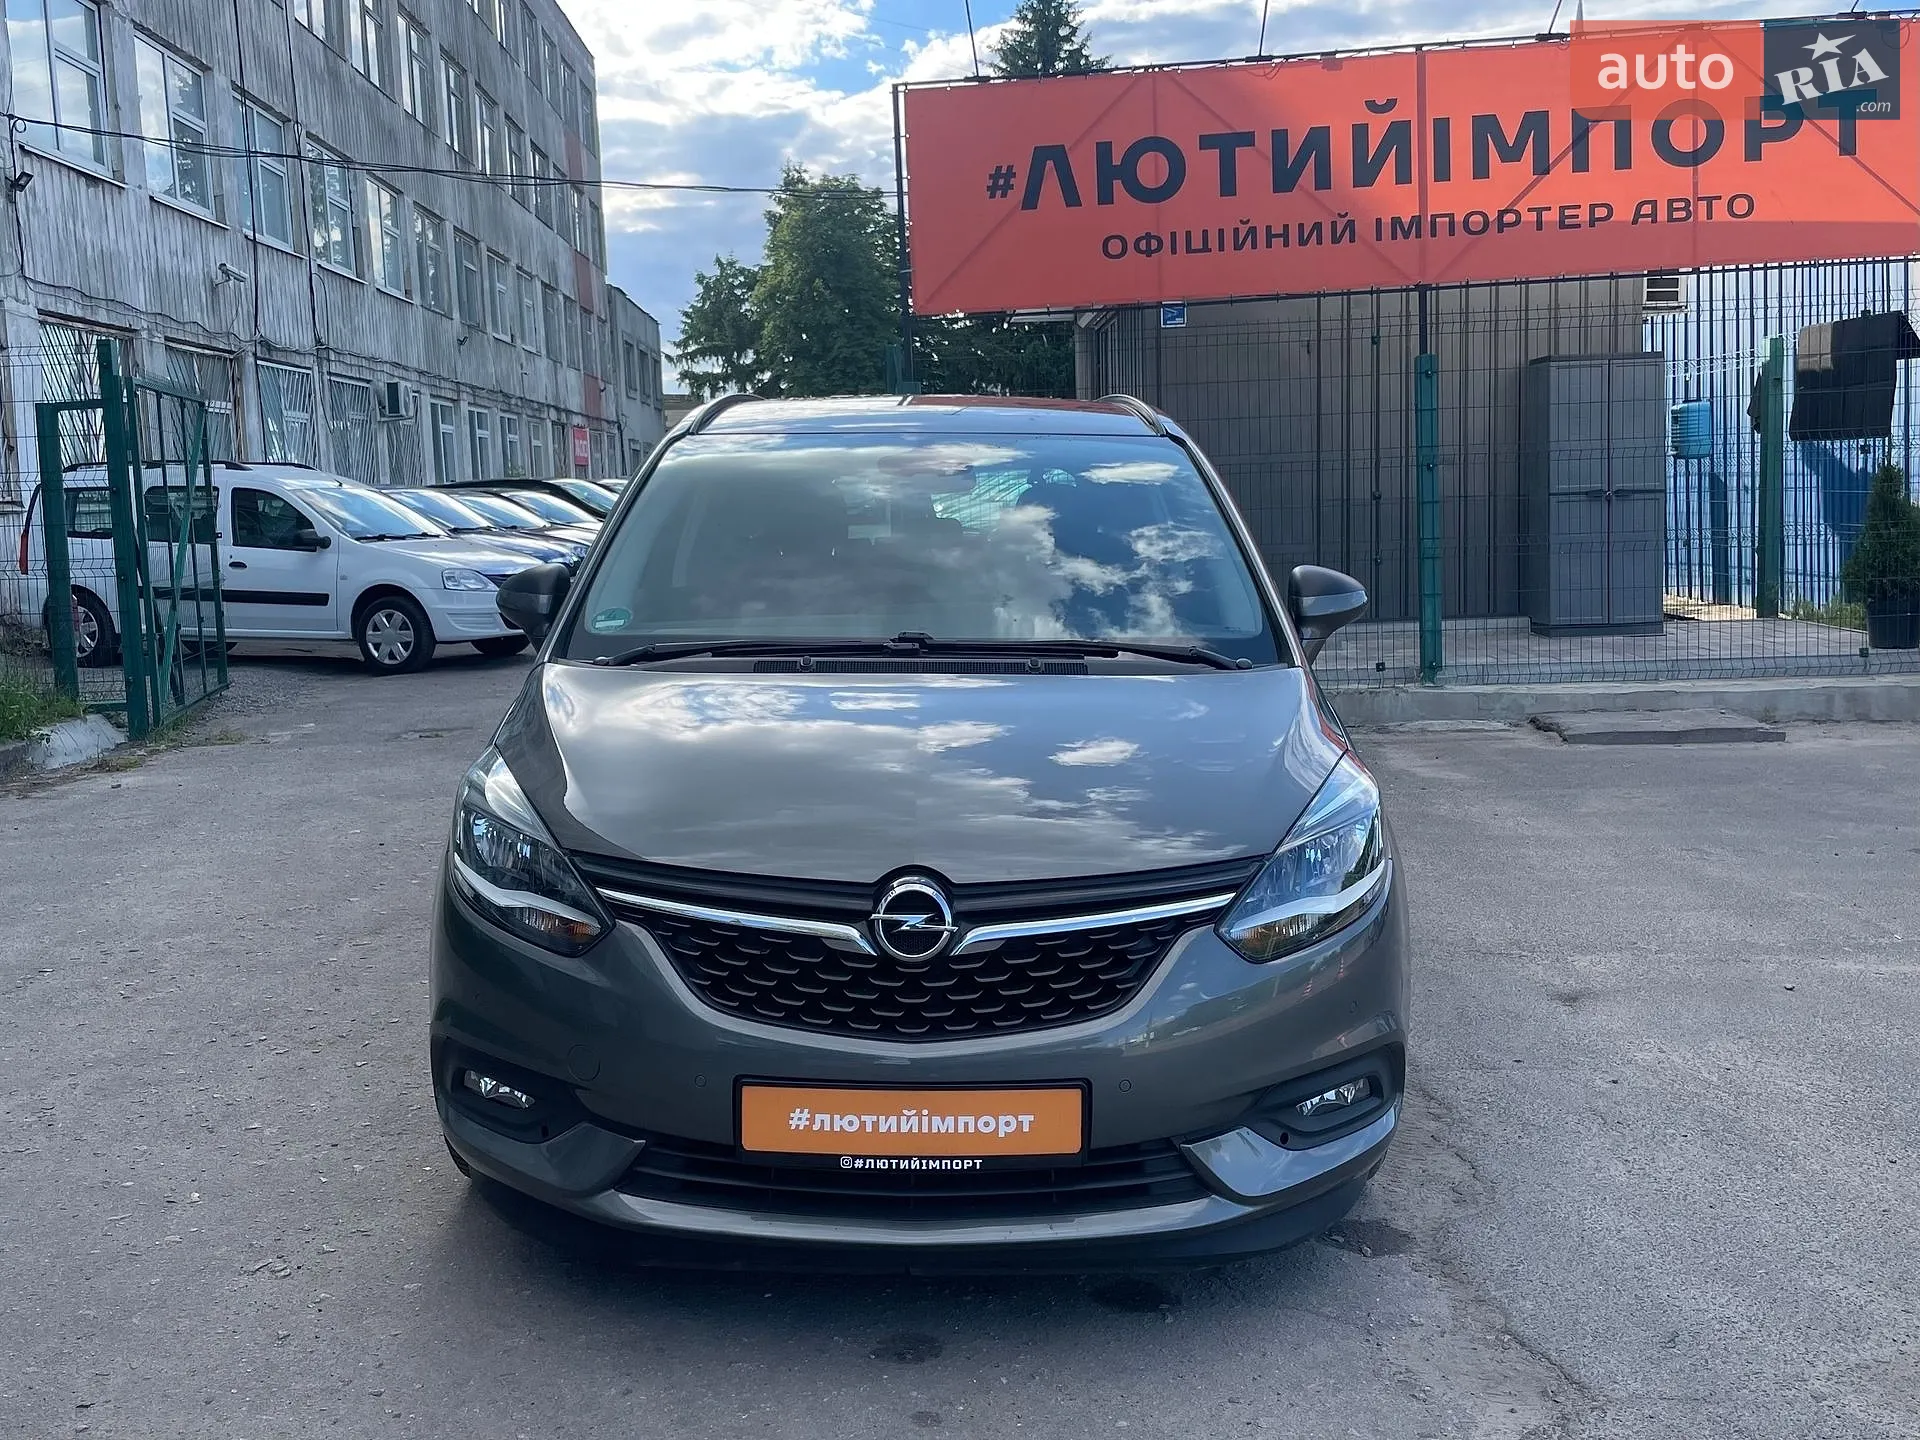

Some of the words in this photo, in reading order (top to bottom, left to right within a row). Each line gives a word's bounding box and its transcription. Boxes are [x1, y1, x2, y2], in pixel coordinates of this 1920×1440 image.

[986, 88, 1878, 211] #ЛЮТИЙІМПОРТ
[1101, 211, 1356, 260] ОФІЦІЙНИЙ
[1374, 202, 1616, 242] ІМПОРТЕР
[1630, 193, 1756, 226] АВТО
[788, 1108, 1036, 1138] #лютийімпорт
[852, 1156, 984, 1171] #ЛЮТИЙІМПОРТ
